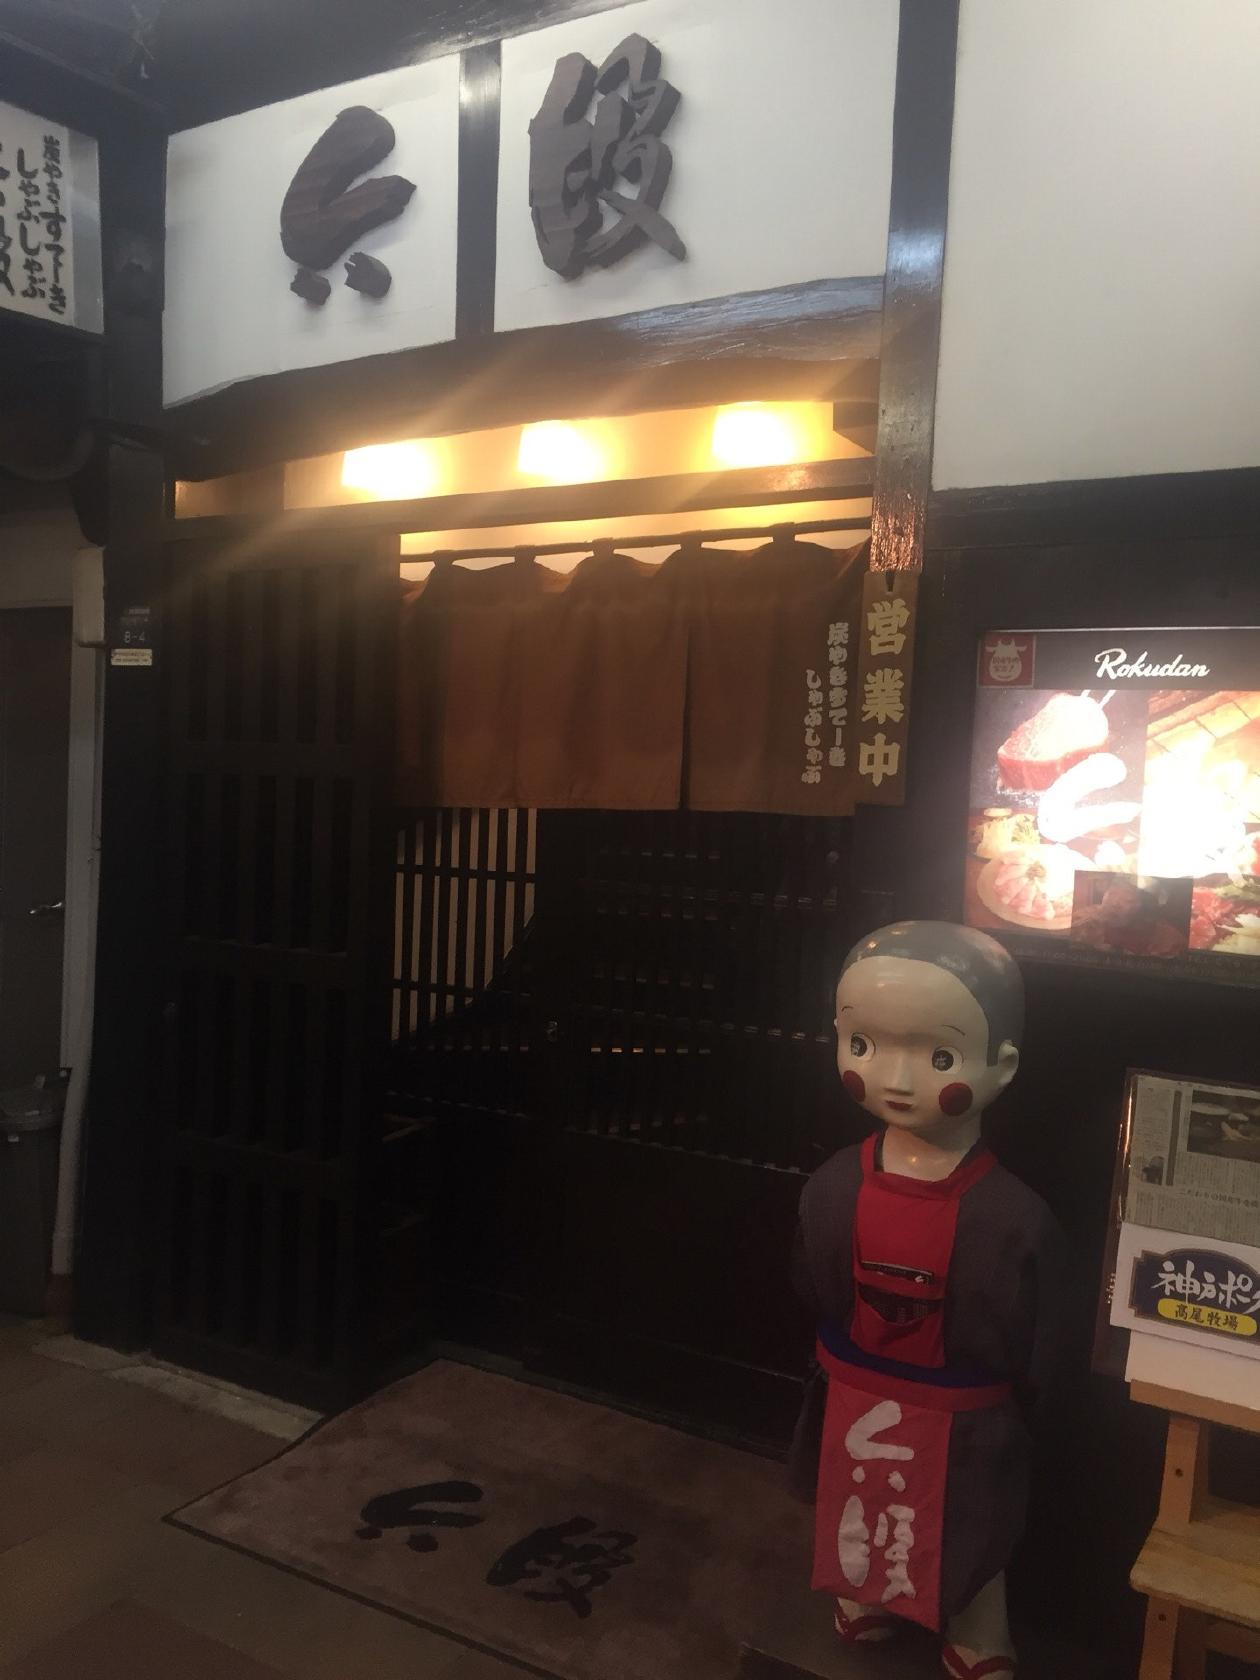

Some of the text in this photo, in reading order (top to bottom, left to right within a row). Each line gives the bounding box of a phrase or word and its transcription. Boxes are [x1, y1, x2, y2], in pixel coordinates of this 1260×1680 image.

[858, 598, 911, 787] 営業中
[1094, 647, 1210, 679] Rokudan
[801, 668, 824, 785] しゃぶしゃぶ
